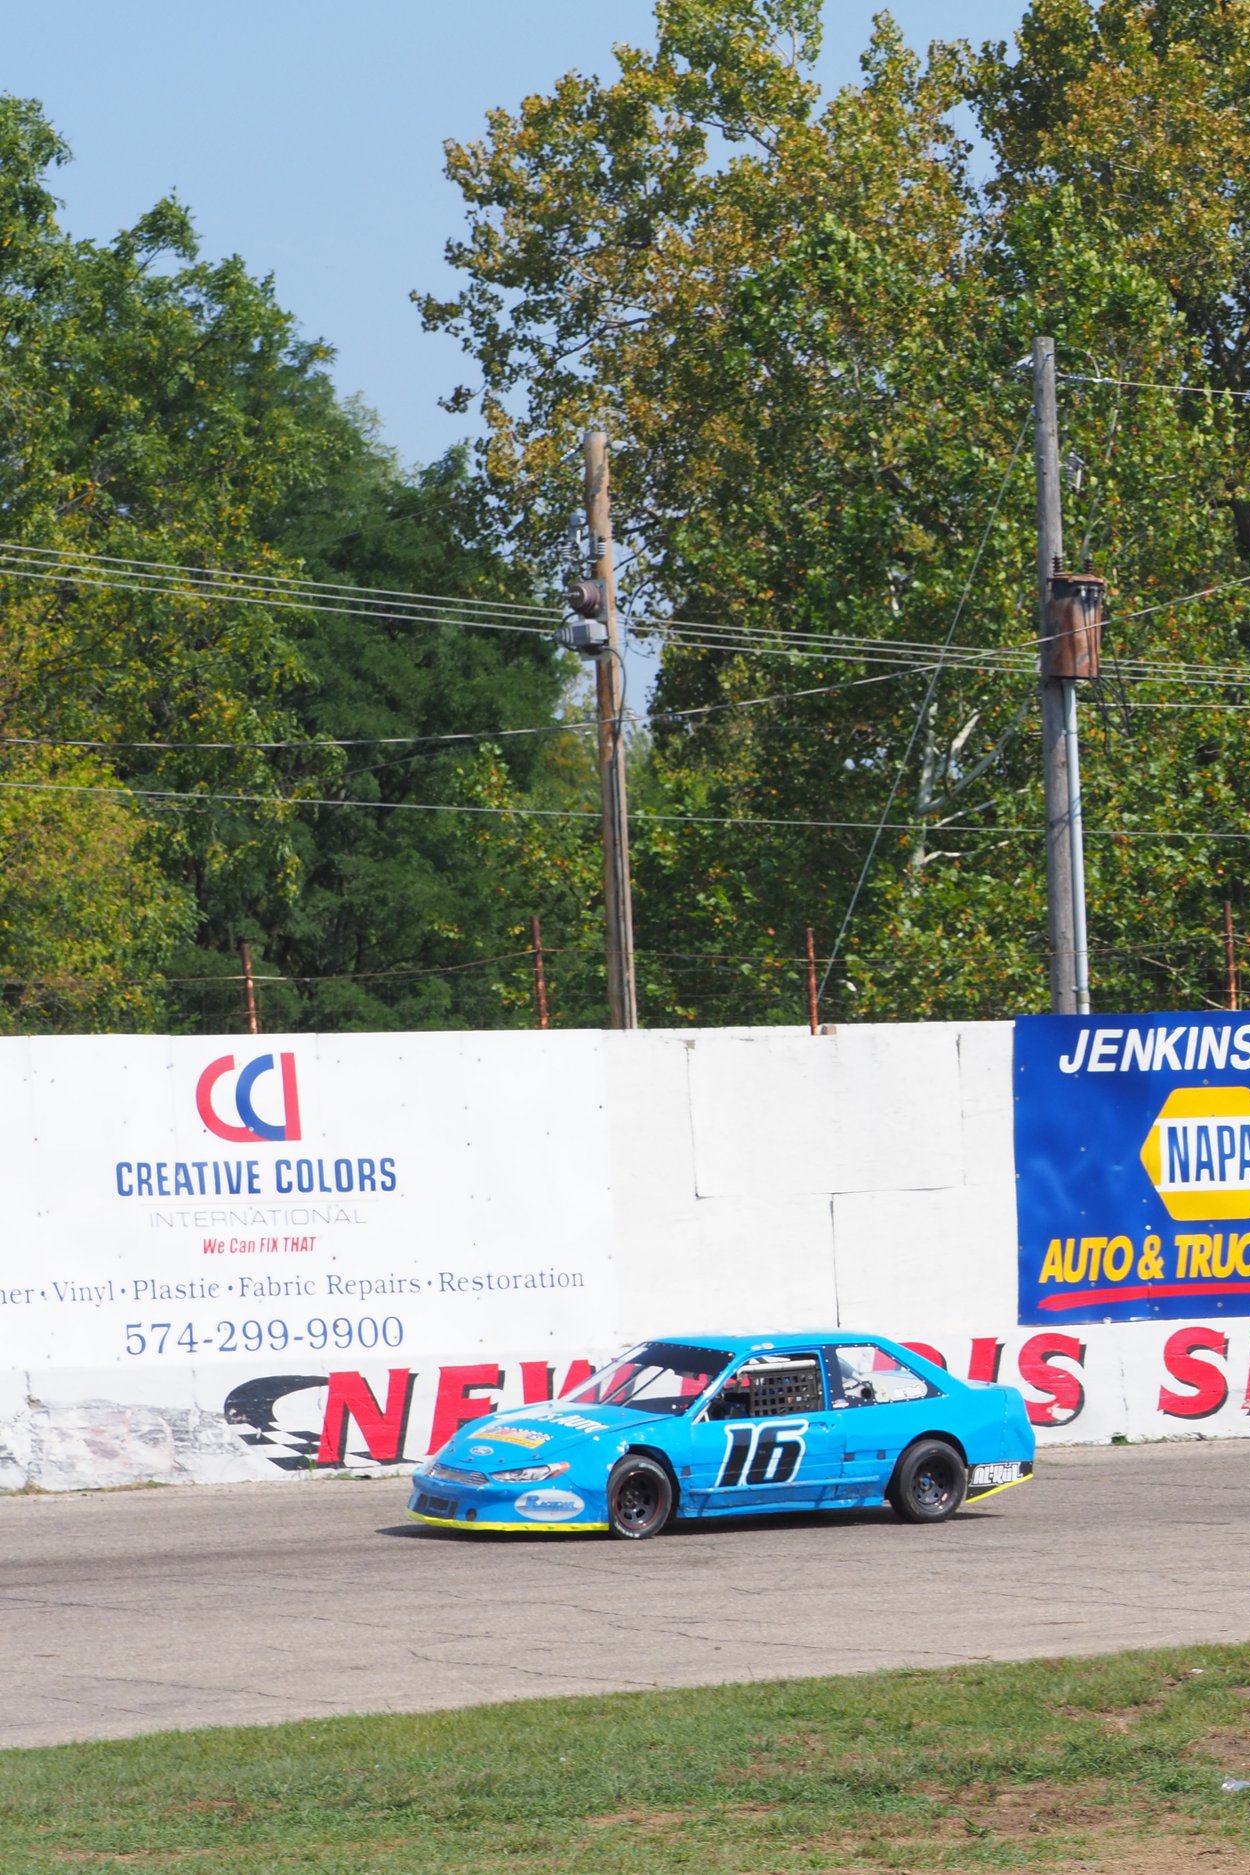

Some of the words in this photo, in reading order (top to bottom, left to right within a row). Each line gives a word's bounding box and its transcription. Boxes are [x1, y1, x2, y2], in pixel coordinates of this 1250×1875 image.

[115, 1159, 262, 1197] CREATIVE
[274, 1157, 397, 1195] COLORS
[149, 1207, 367, 1229] INTERNATIONAL
[203, 1238, 226, 1255] We
[229, 1237, 256, 1254] Can
[259, 1237, 279, 1253] FIX
[283, 1236, 316, 1253] THAT
[1039, 1235, 1134, 1284] AUTO
[1137, 1234, 1165, 1281] &
[52, 1280, 114, 1307] Vinyl
[133, 1278, 220, 1301] Plastic
[239, 1275, 316, 1298] Fabric
[326, 1272, 421, 1301] Repairs
[439, 1266, 585, 1293] Restoration
[125, 1316, 405, 1356] 574-299-9900
[714, 1418, 809, 1489] 16
